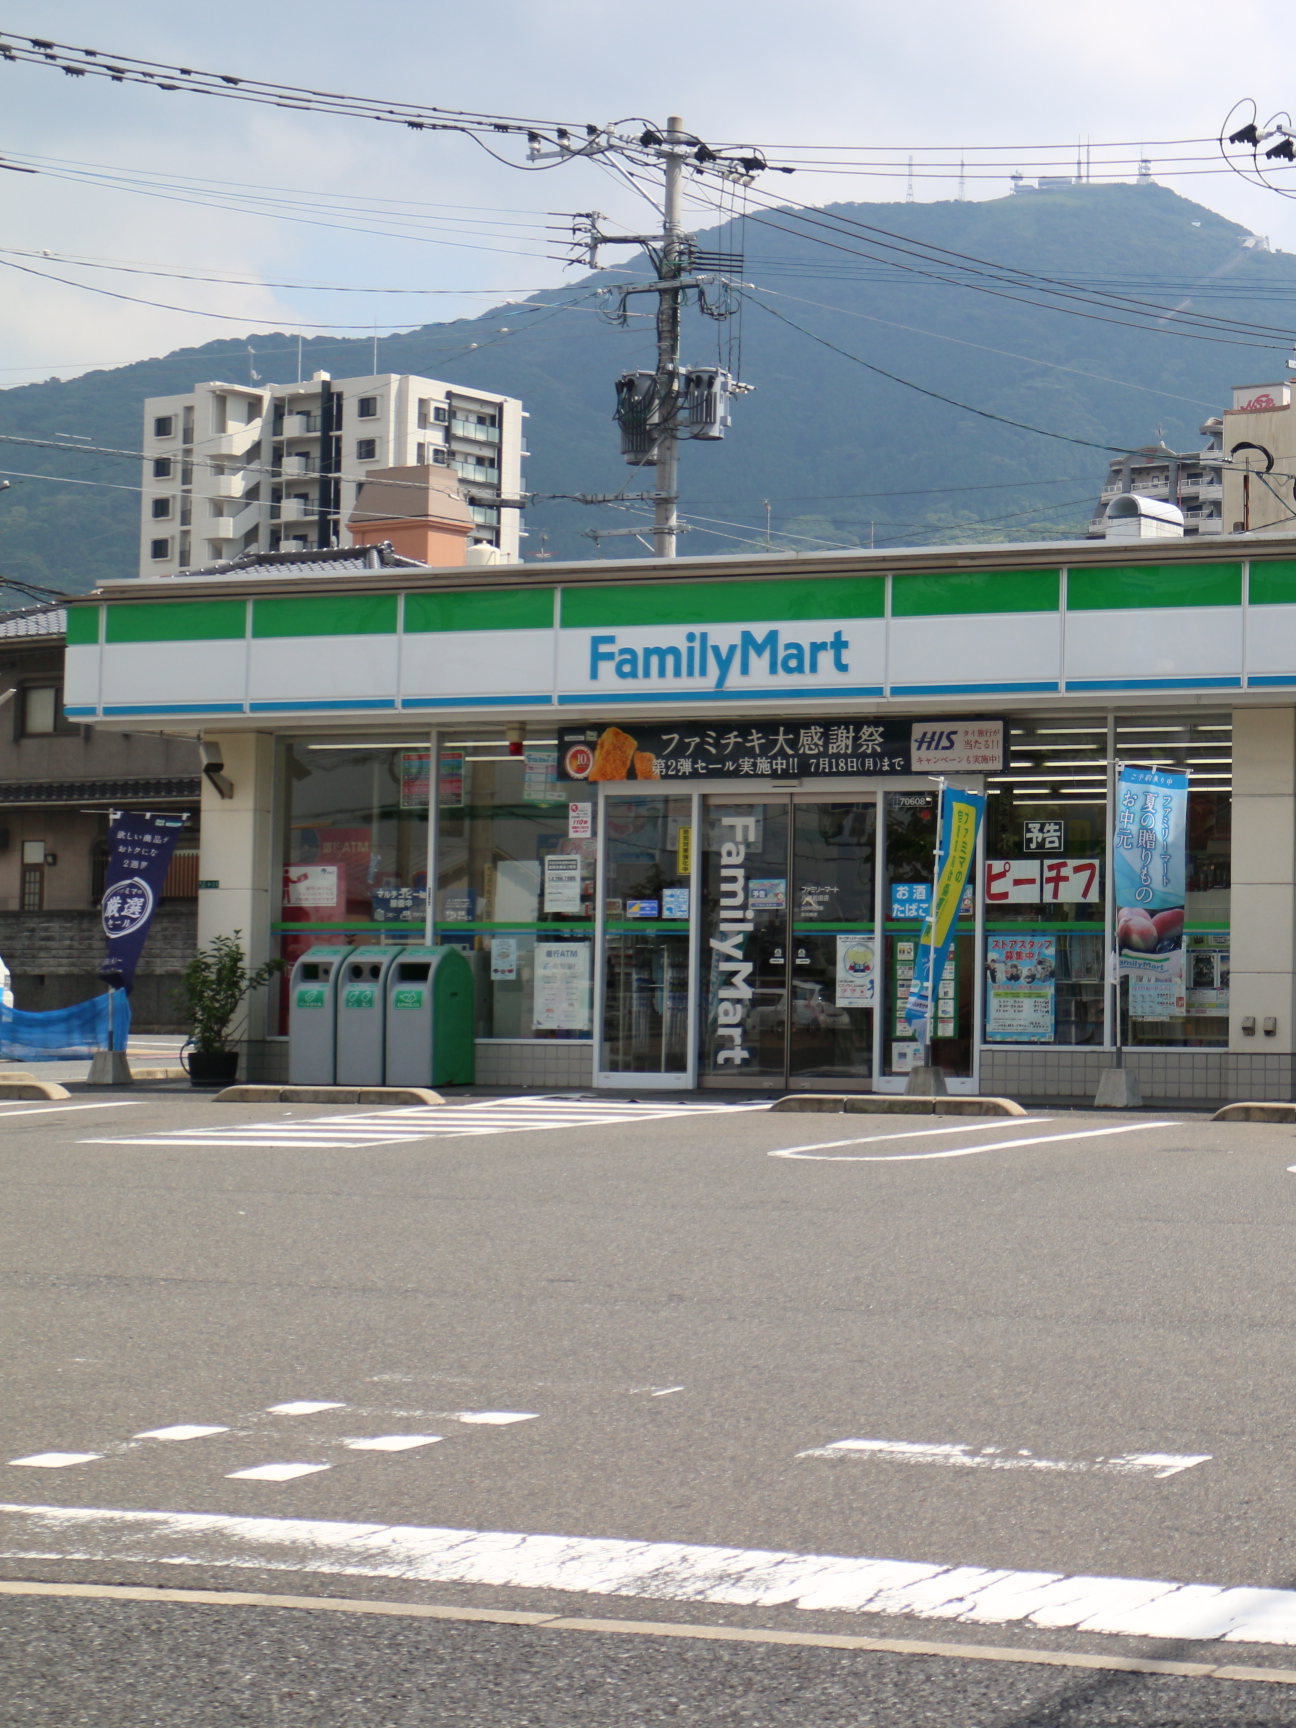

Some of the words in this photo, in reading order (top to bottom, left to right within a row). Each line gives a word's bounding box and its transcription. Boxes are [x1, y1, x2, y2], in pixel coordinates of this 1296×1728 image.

[590, 629, 850, 690] FamilyMart
[661, 725, 886, 756] ファミチキ大感謝祭
[900, 797, 926, 806] 70608
[1116, 790, 1138, 850] お中元
[1025, 822, 1061, 849] 予告
[1135, 792, 1158, 904] 夏の贈りもの
[1161, 795, 1172, 887] ファミリーマート
[896, 885, 927, 900] お酒
[104, 895, 145, 919] 厳選
[892, 902, 930, 917] たばこ
[107, 918, 132, 929] セール
[709, 817, 756, 1065] FamilyMart
[991, 940, 1053, 950] ストアスタッフ
[1120, 959, 1164, 971] amilyMart
